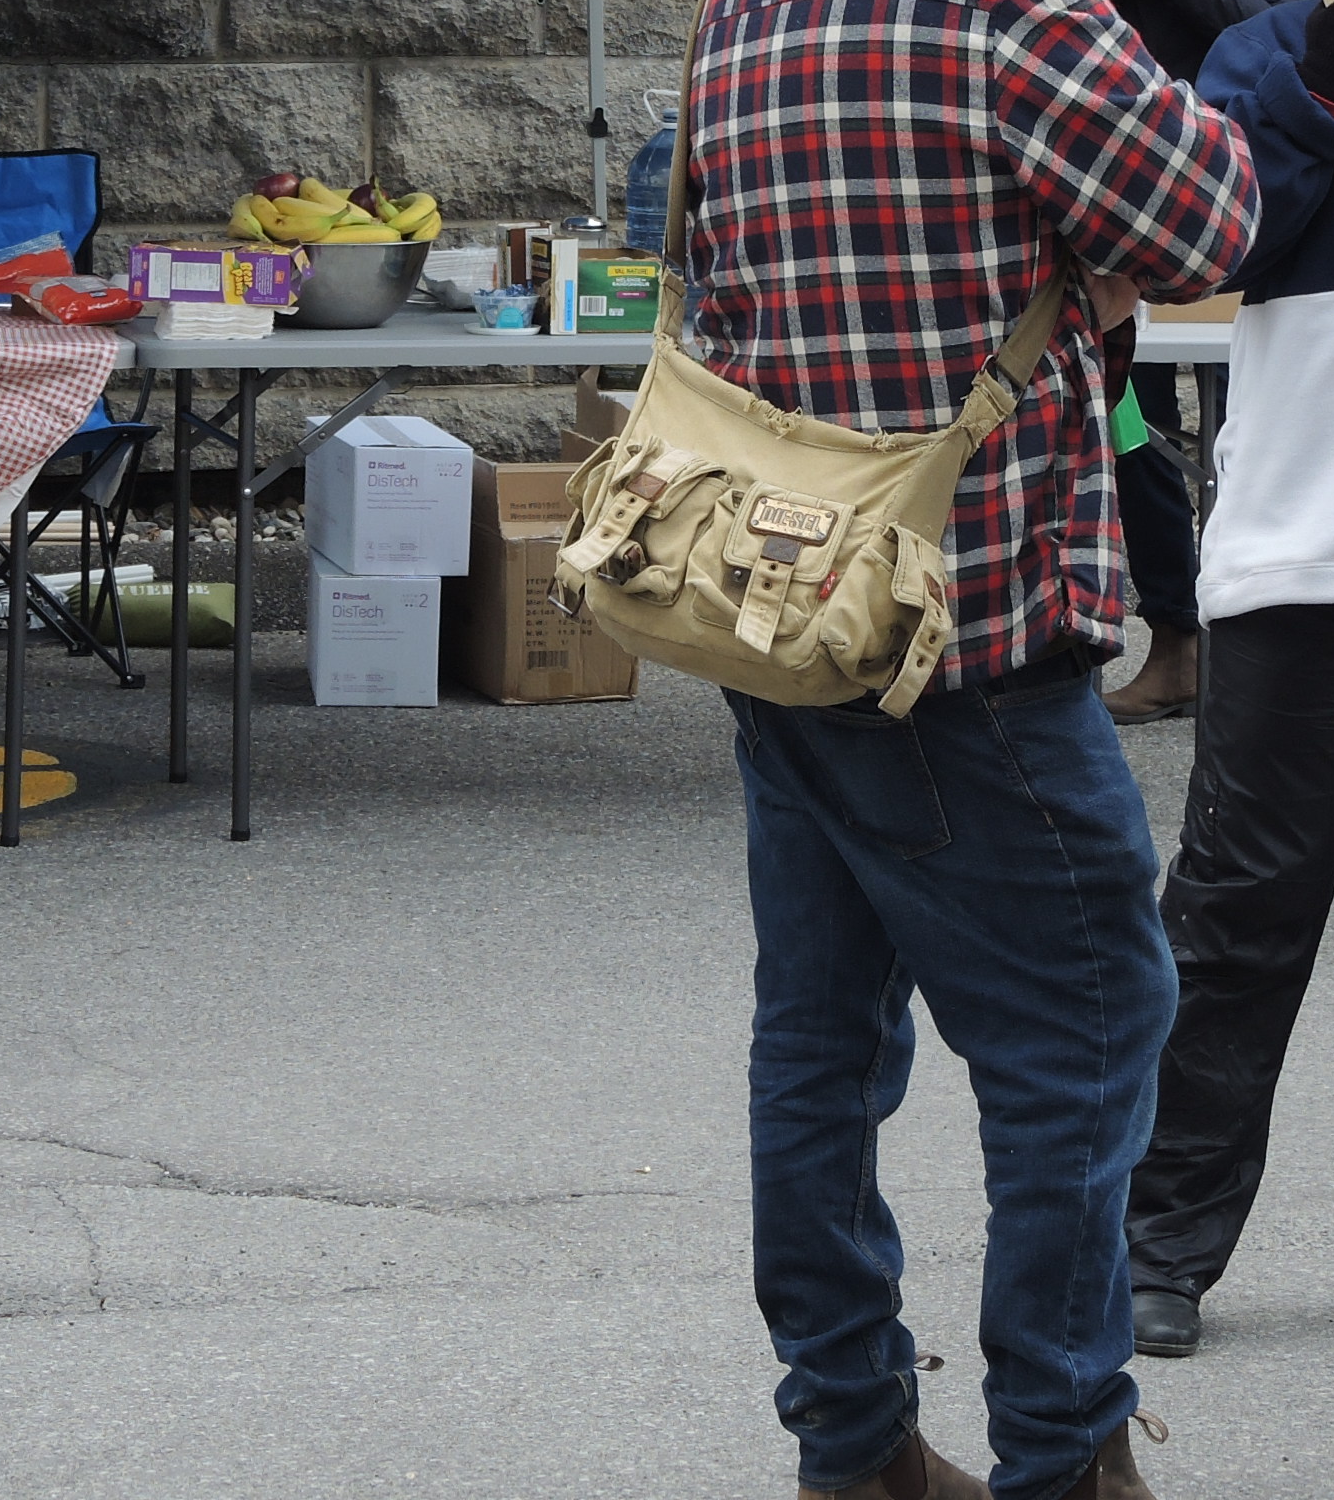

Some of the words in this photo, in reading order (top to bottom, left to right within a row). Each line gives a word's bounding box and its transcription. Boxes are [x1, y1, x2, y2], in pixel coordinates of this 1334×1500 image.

[368, 474, 418, 488] DisTech
[759, 505, 821, 532] DIESEL
[332, 604, 384, 619] DisTech
